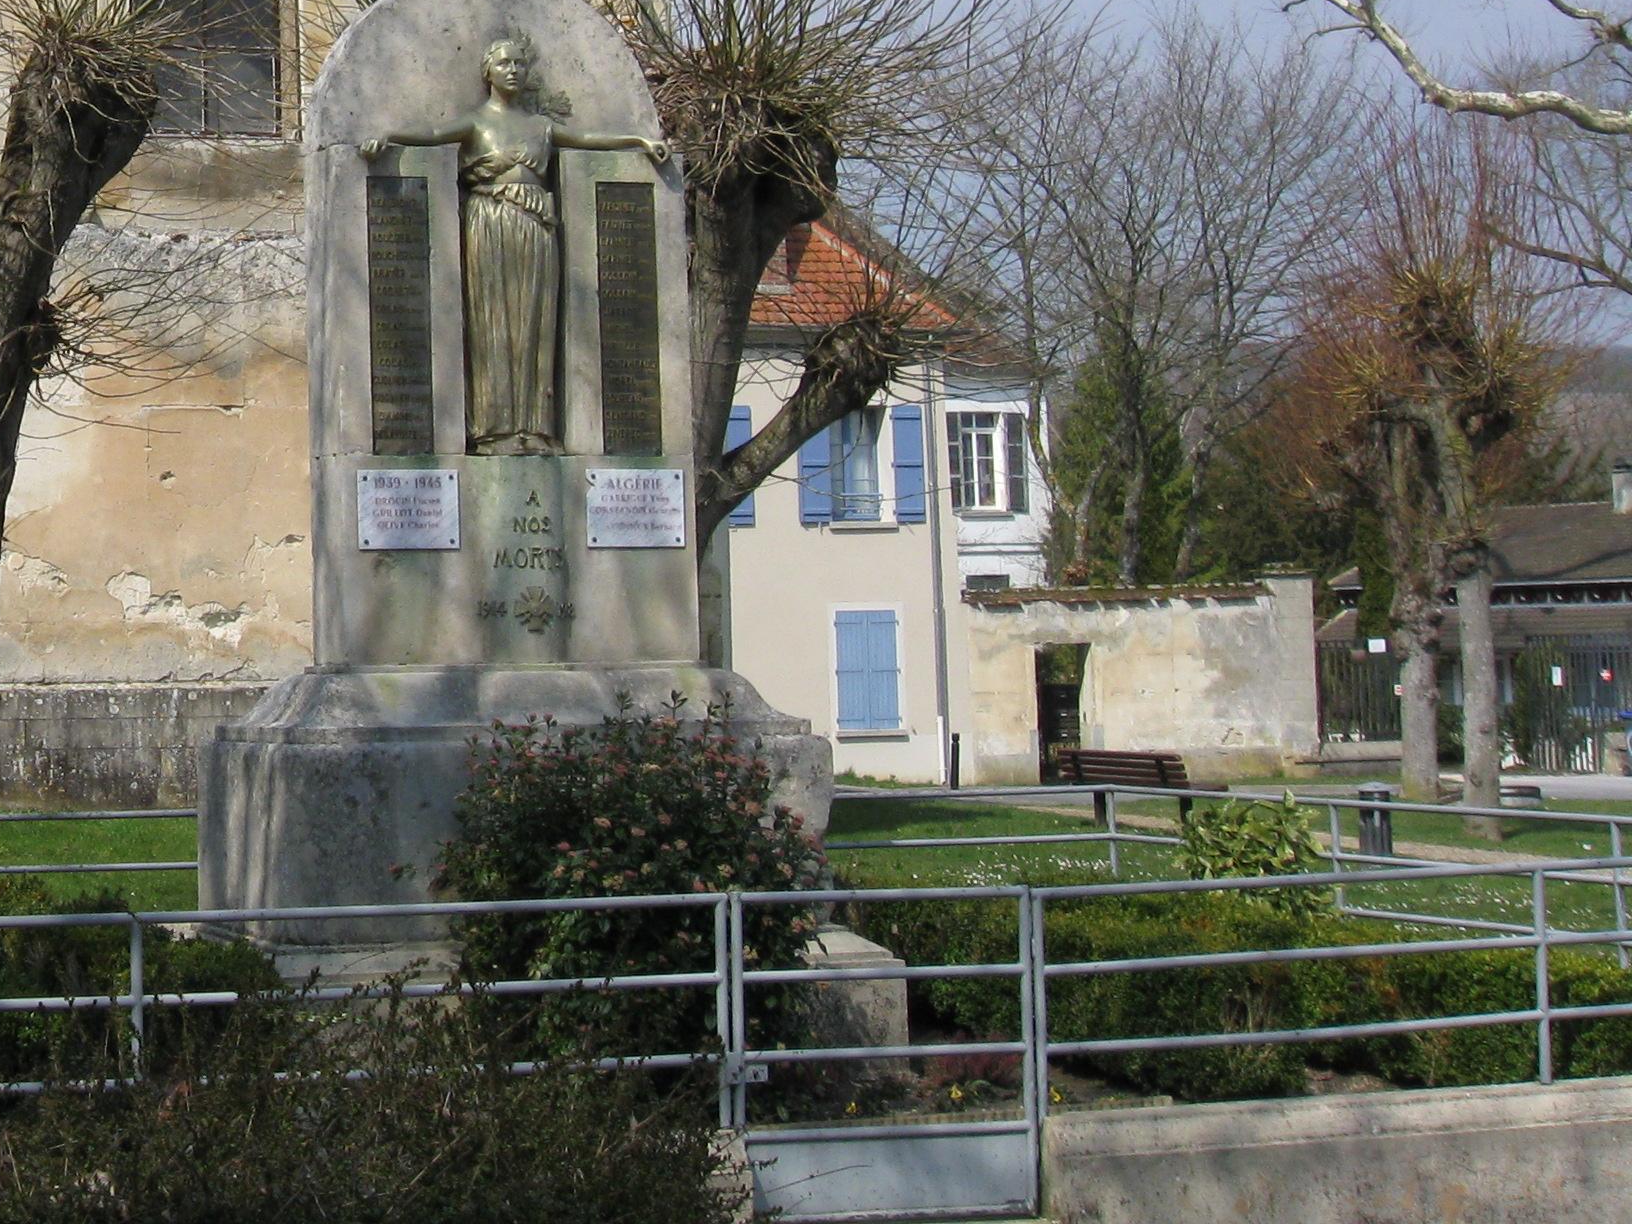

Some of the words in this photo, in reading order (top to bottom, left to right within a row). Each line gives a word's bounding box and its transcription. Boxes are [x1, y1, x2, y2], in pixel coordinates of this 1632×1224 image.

[374, 476, 401, 489] 1939
[414, 476, 442, 489] 1945
[605, 474, 662, 490] ALGÉRIE
[525, 489, 541, 507] A
[512, 516, 553, 534] NOS
[493, 546, 567, 571] MORTS
